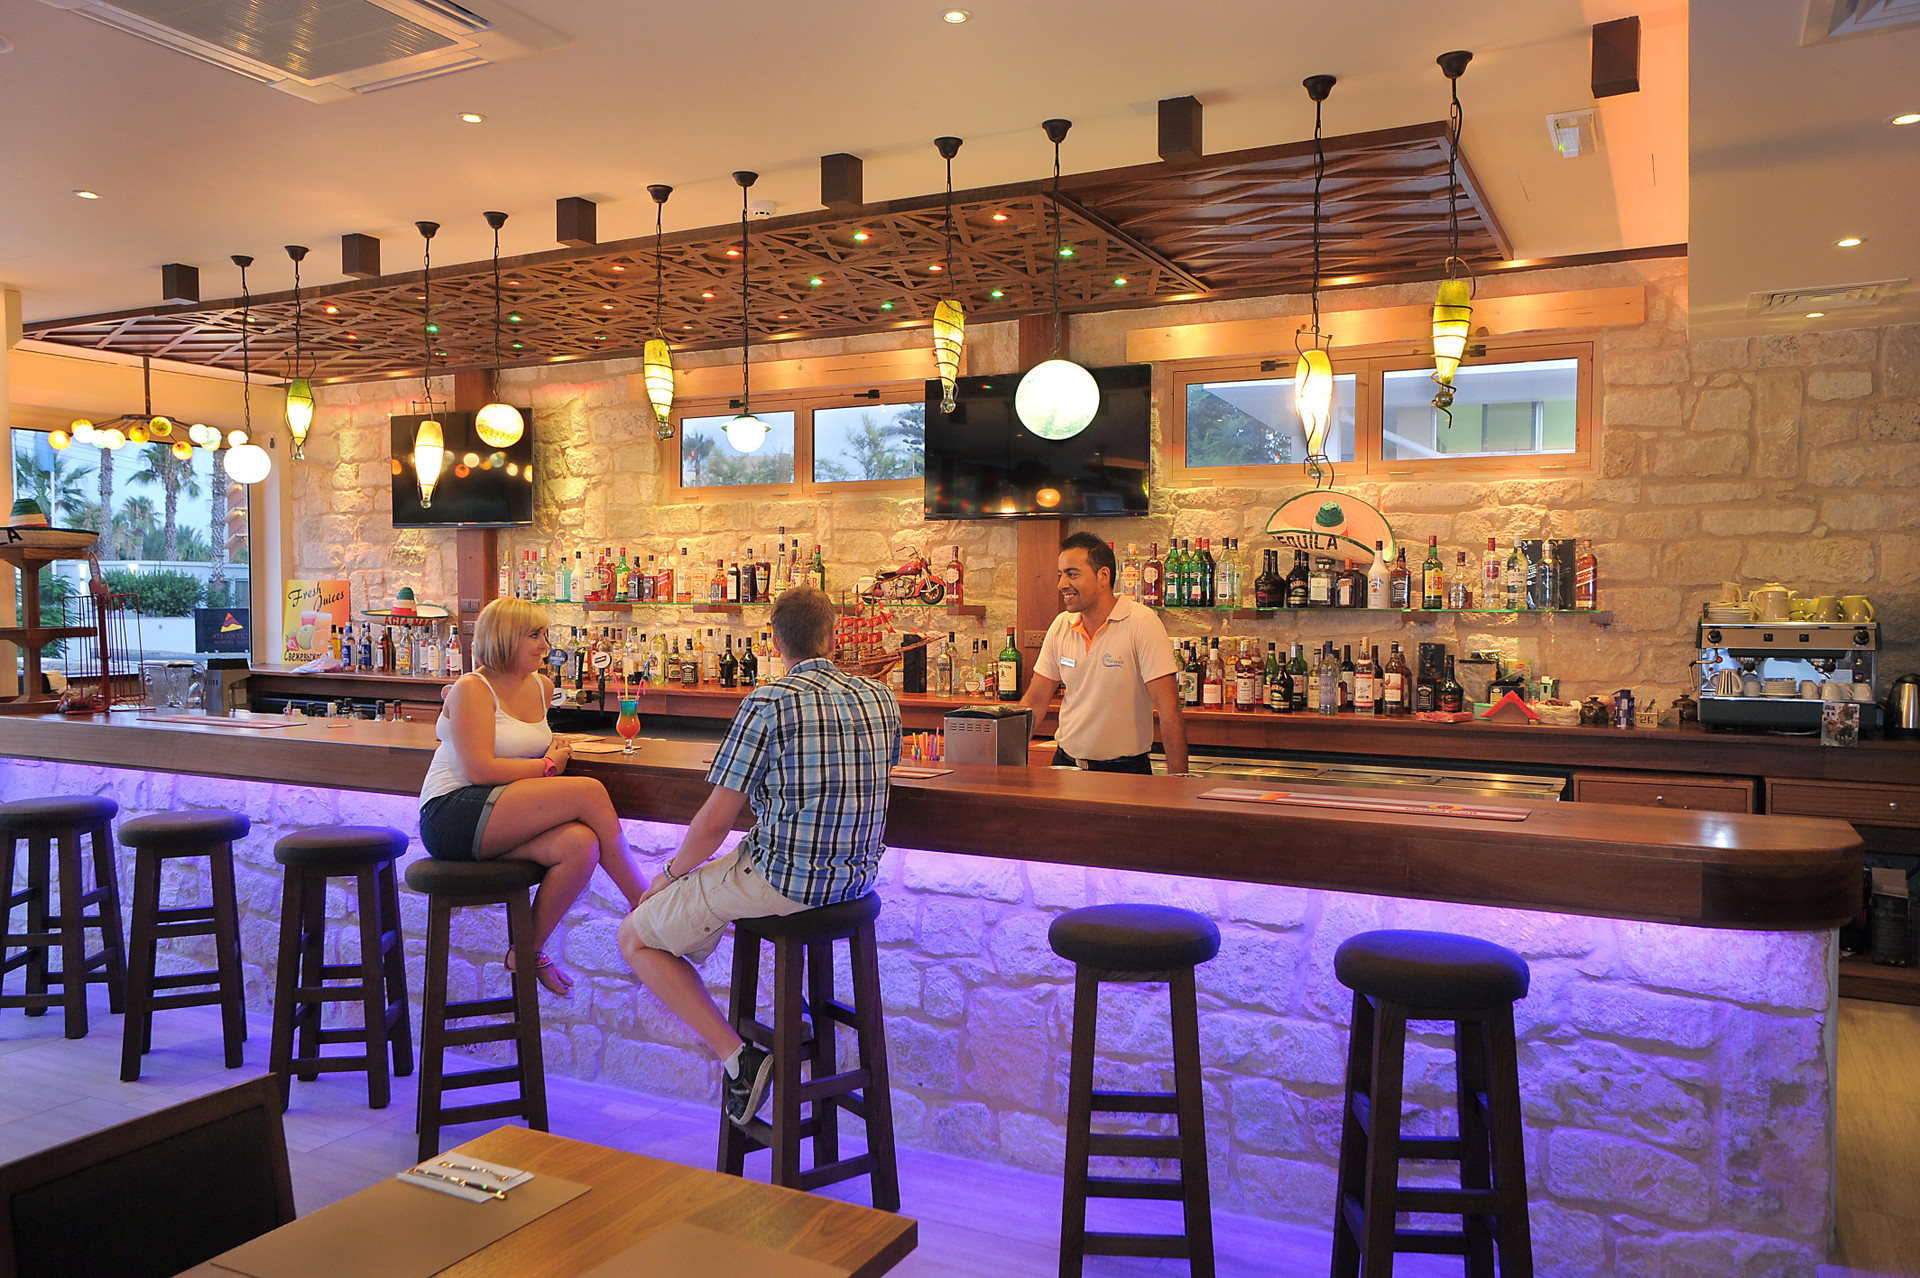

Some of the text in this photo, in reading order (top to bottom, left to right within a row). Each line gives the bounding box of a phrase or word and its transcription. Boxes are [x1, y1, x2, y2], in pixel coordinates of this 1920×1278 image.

[1272, 533, 1338, 550] EQUILA
[288, 581, 321, 608] Fresh
[313, 590, 344, 612] Juices
